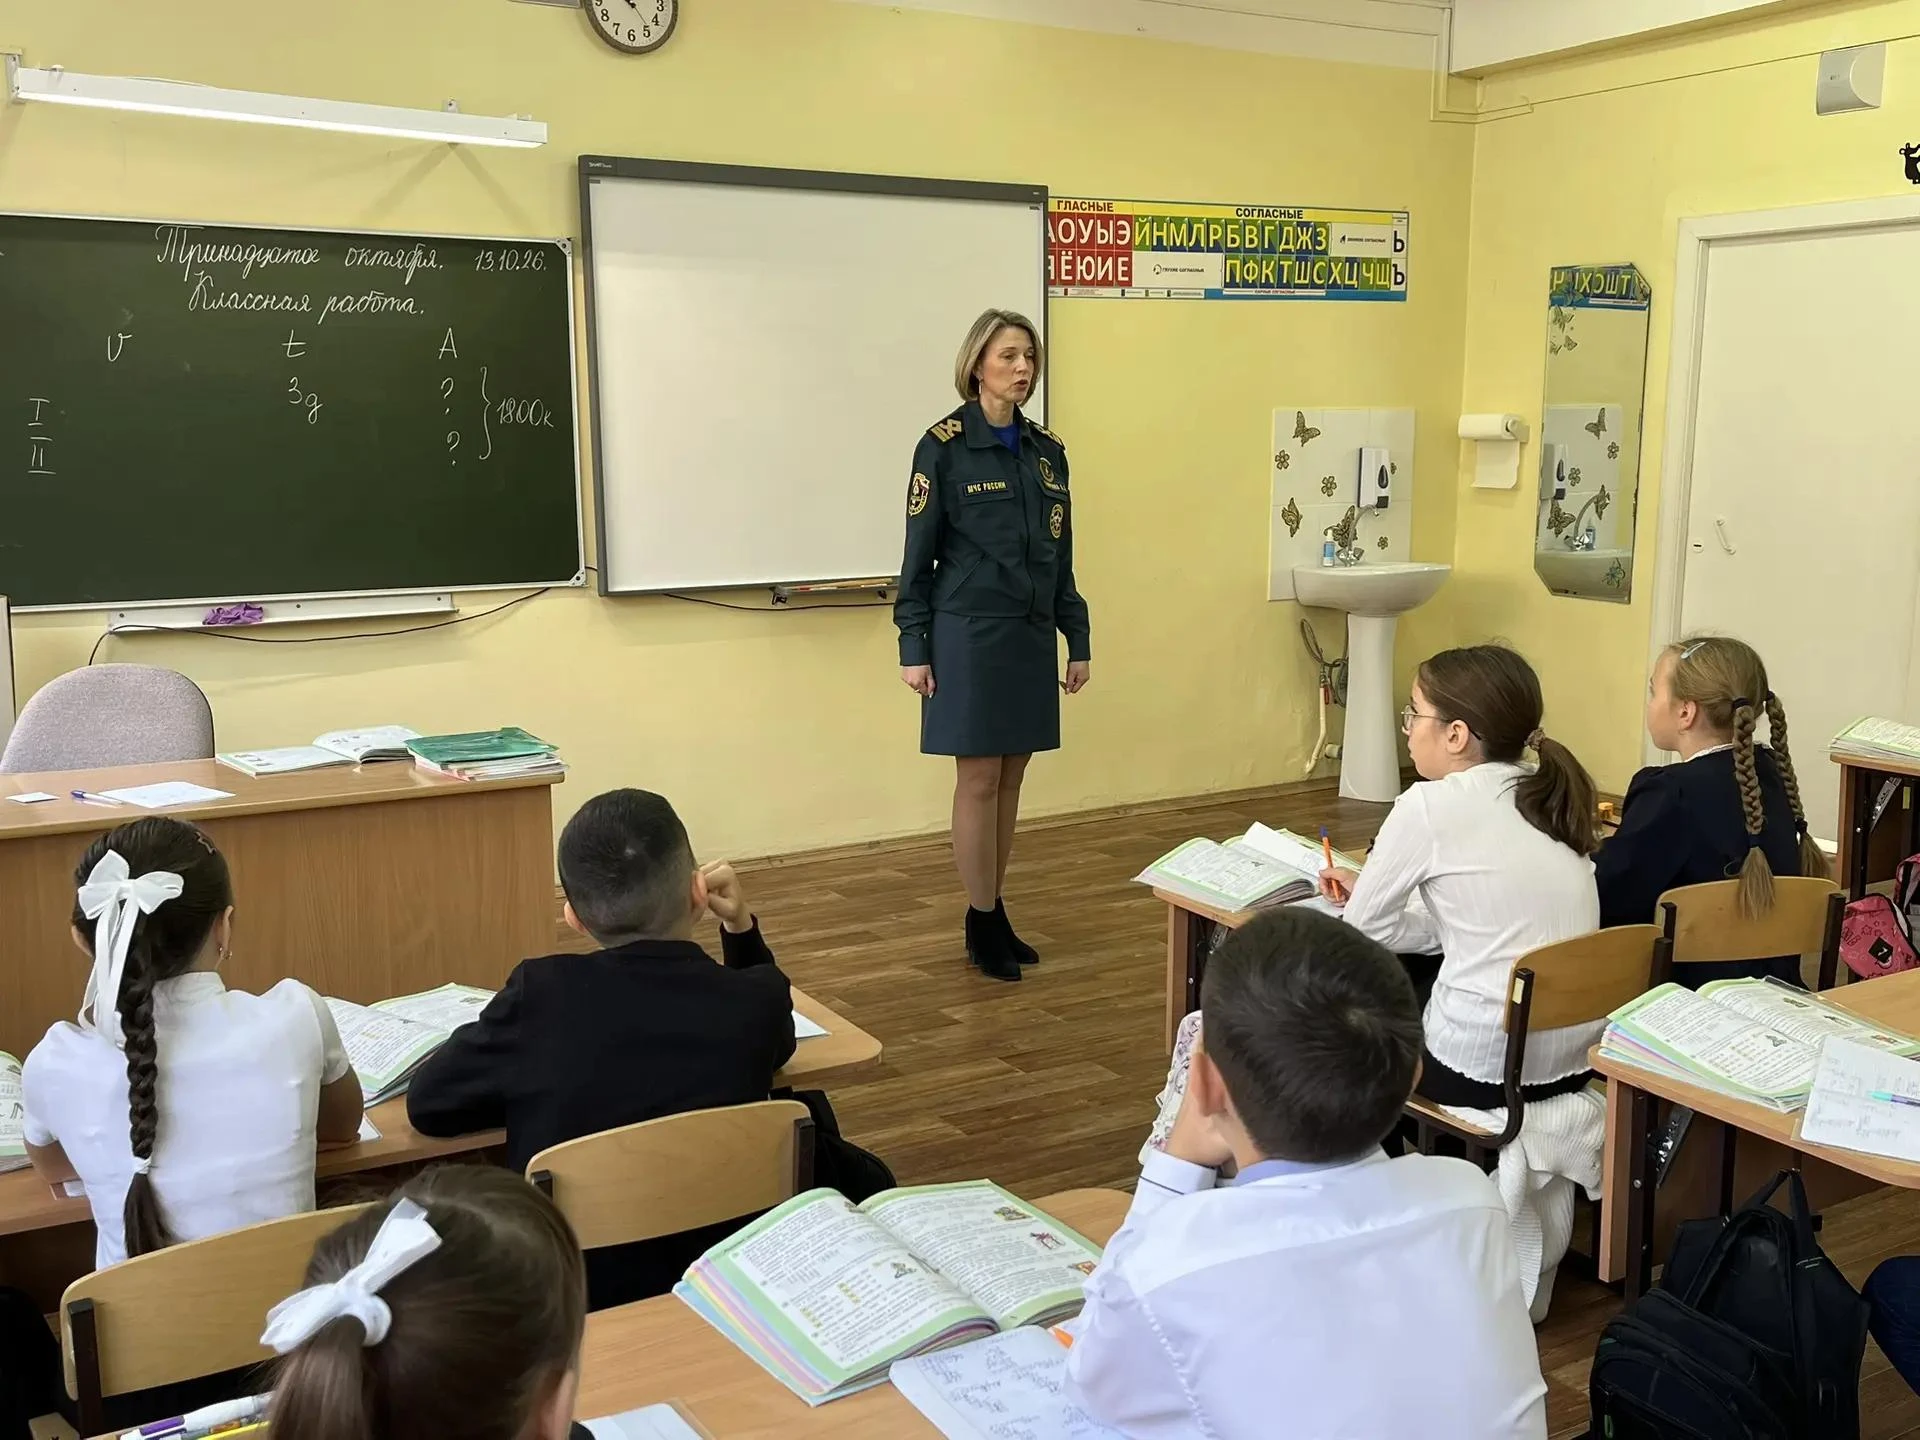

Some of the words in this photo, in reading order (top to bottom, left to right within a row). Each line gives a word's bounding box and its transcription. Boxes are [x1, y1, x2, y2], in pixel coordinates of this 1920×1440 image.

[656, 0, 664, 12] 3
[601, 8, 610, 22] 8
[651, 13, 660, 26] 4
[612, 22, 621, 35] 7
[643, 25, 651, 38] 5
[627, 29, 636, 42] 6
[1057, 200, 1114, 212] ГЛАСНЫЕ
[1236, 207, 1304, 220] СОГЛАСНЫЕ
[154, 224, 320, 282] Тринадцатое
[344, 243, 444, 285] октября.
[474, 248, 547, 272] 13.10.26.
[188, 270, 313, 312] Классная
[318, 290, 425, 325] работа.
